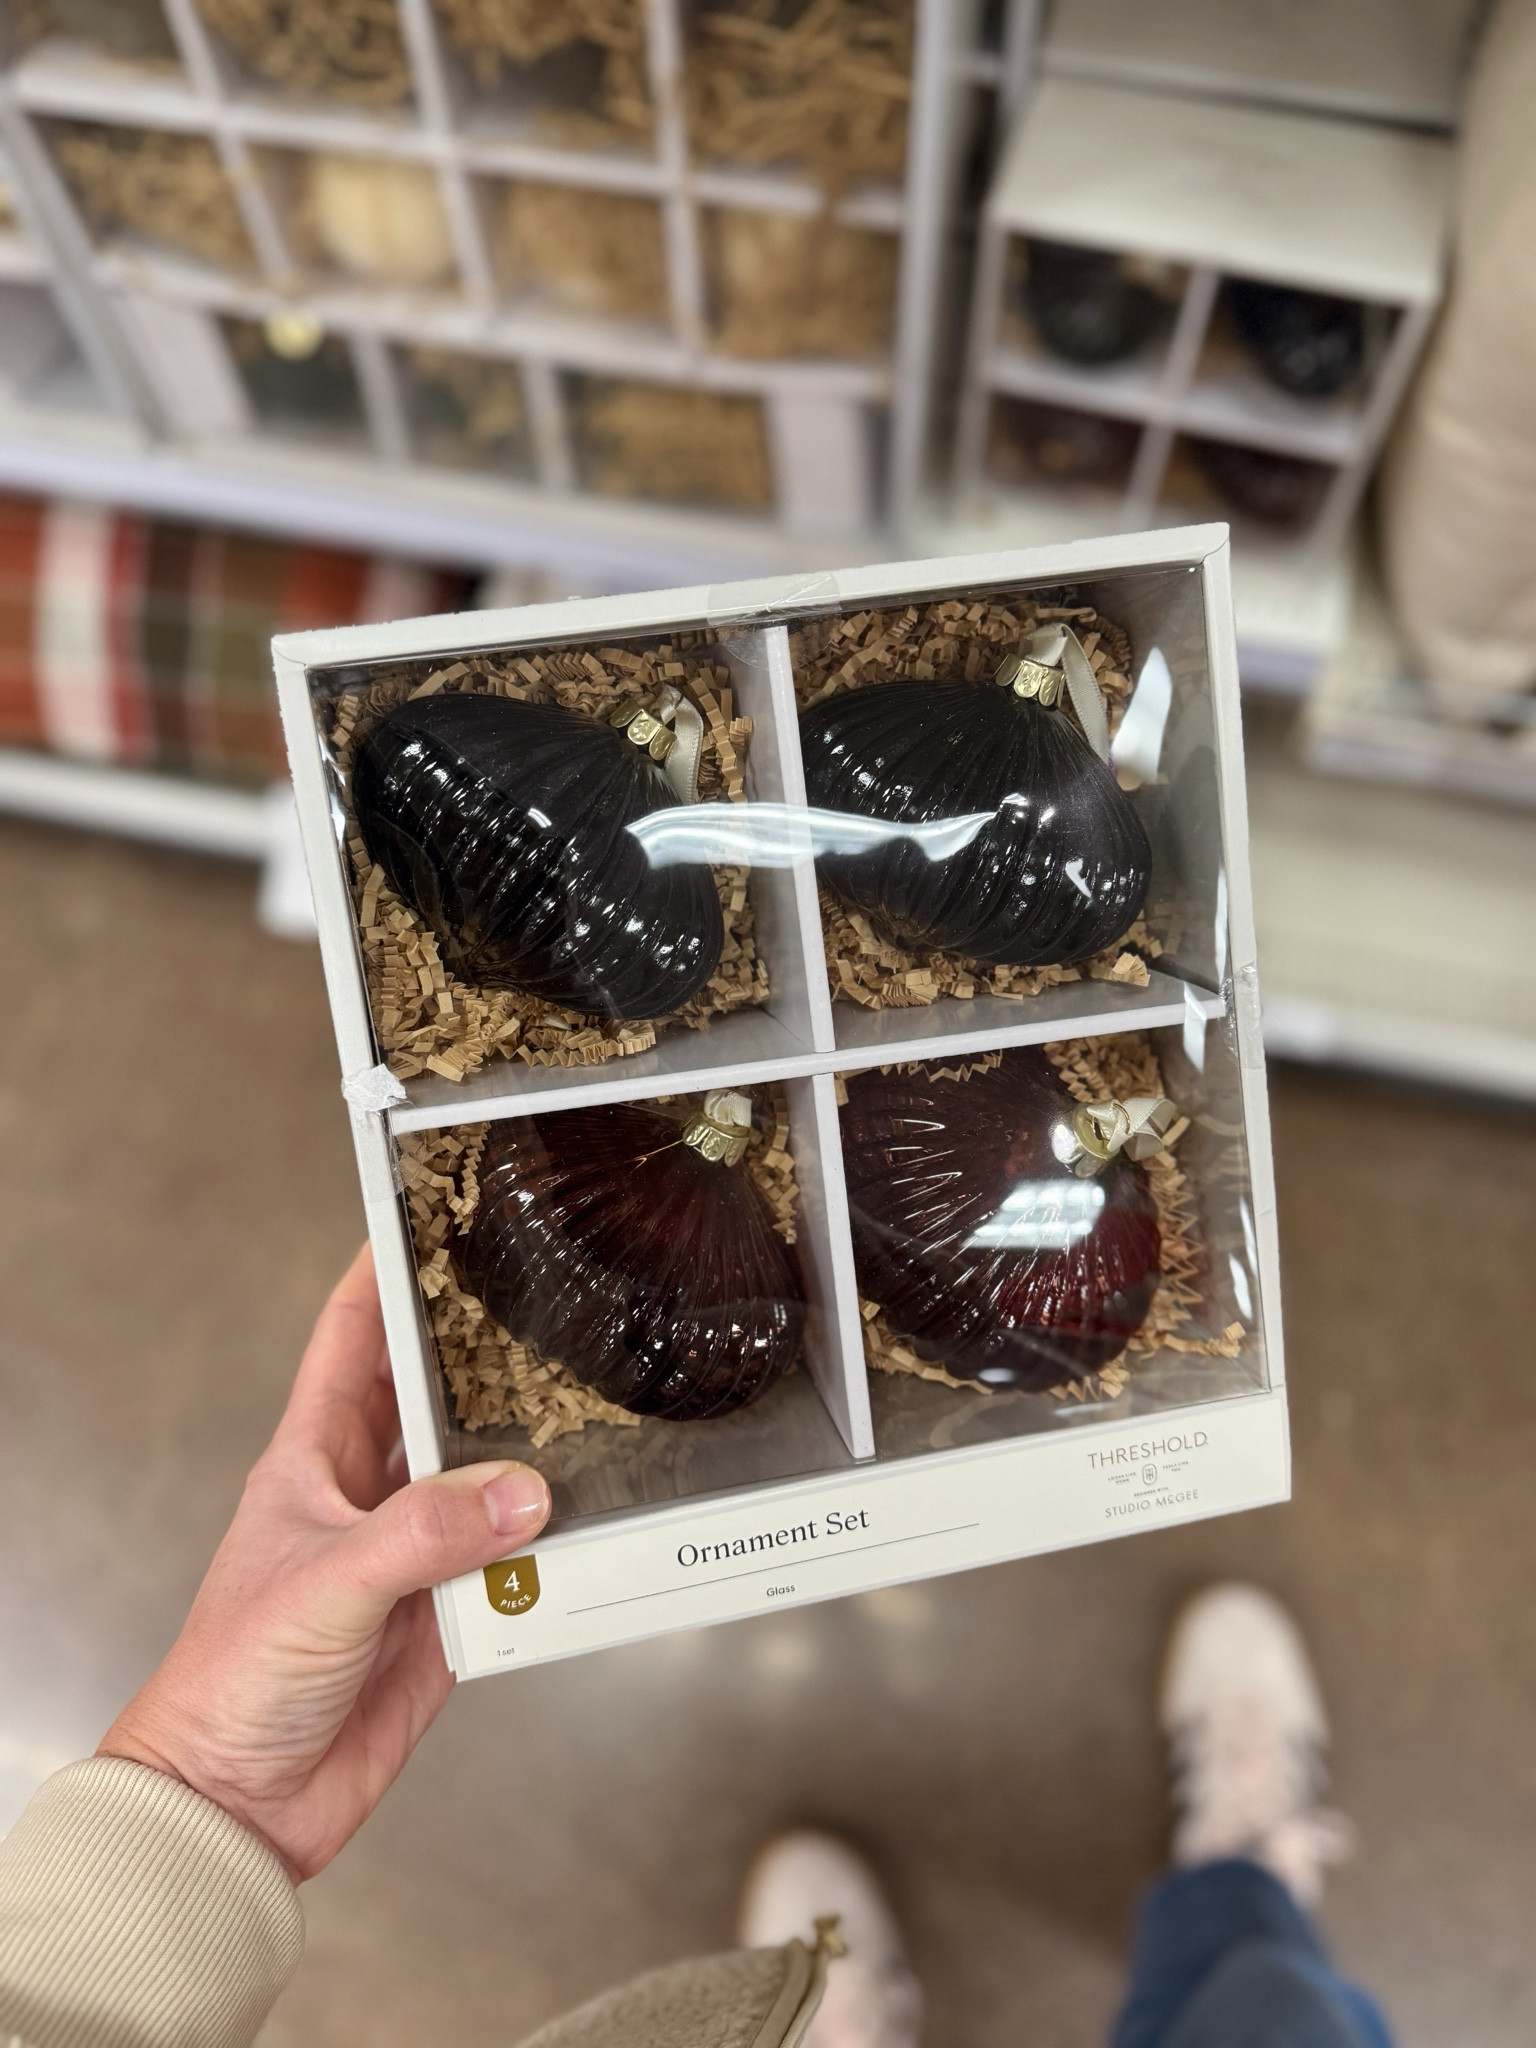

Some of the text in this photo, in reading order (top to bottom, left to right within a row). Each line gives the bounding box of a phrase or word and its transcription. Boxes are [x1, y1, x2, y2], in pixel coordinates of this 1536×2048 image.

[1087, 1431, 1208, 1469] THRESHOLD
[1105, 1499, 1151, 1518] STUDIO
[677, 1509, 870, 1567] Ornament Set
[504, 1570, 520, 1592] 4
[766, 1584, 796, 1597] Glass
[500, 1593, 532, 1609] PIECE
[502, 1647, 515, 1655] set
